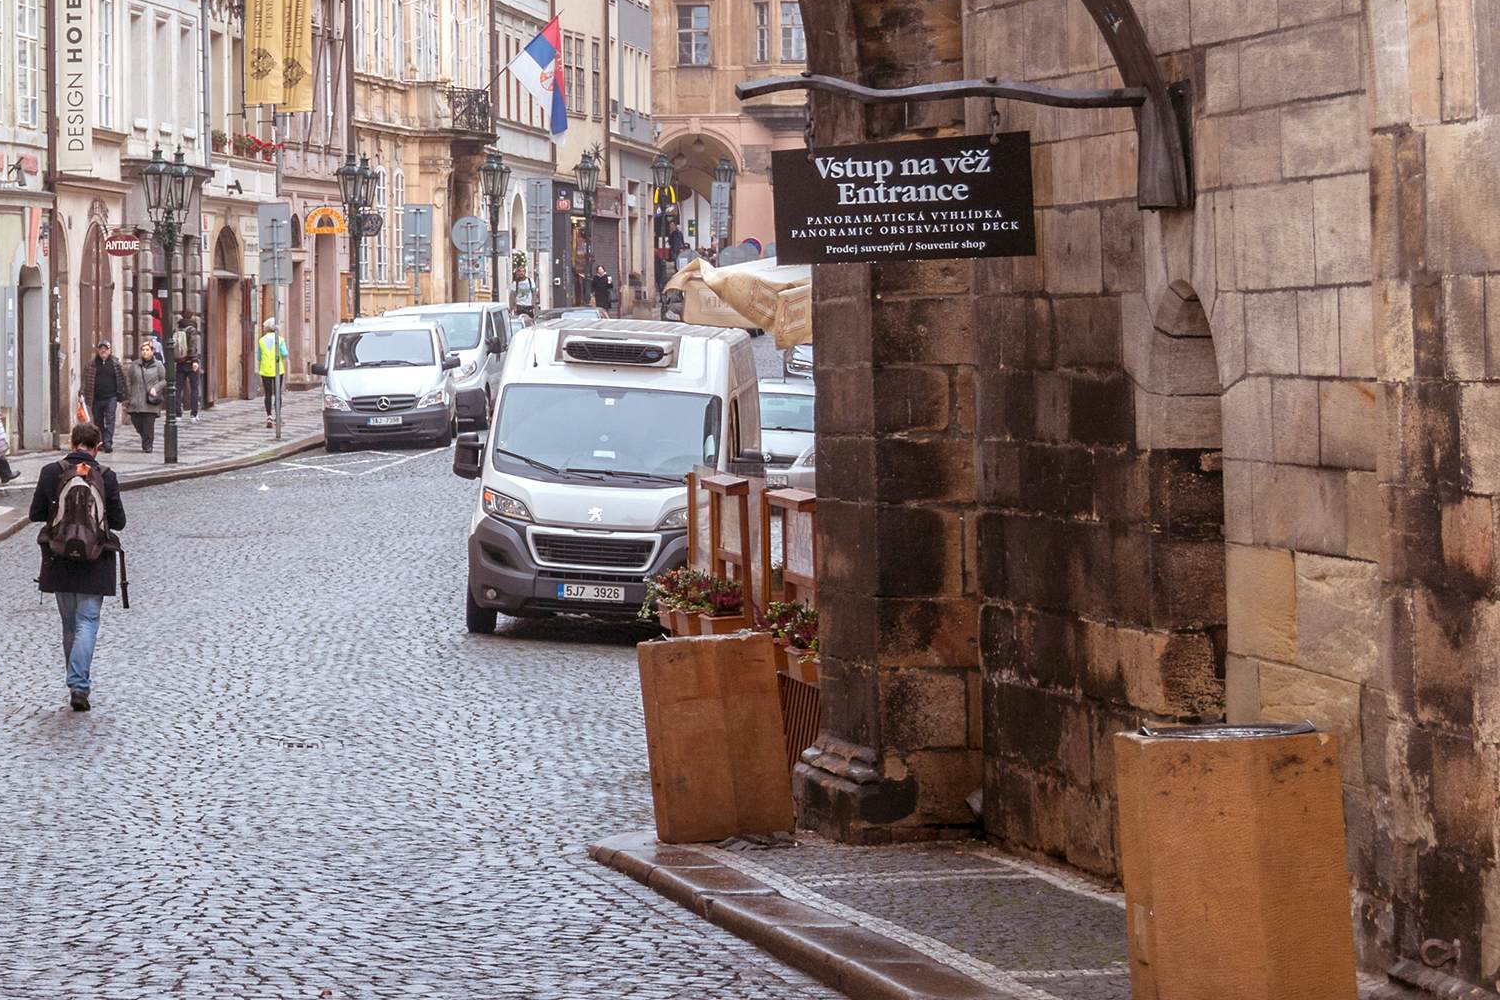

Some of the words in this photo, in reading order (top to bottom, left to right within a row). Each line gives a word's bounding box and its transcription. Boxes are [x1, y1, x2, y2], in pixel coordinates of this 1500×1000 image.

[66, 73, 84, 151] DESIGN
[814, 156, 894, 184] Vstup
[900, 158, 938, 176] na
[941, 149, 991, 174] věž
[837, 183, 970, 205] Entrance
[806, 210, 925, 226] PANORAMATICKÁ
[931, 208, 1003, 221] VYHLÍDKA
[791, 226, 874, 239] PANORAMIC
[879, 222, 976, 235] OBSERVATION
[982, 220, 1020, 232] DECK
[825, 244, 858, 255] Prodej
[860, 242, 906, 254] suvenýrů
[907, 242, 914, 252] /
[915, 240, 959, 251] Souvenir
[961, 239, 987, 250] shop
[566, 585, 586, 598] 5J7
[593, 587, 620, 599] 3926
